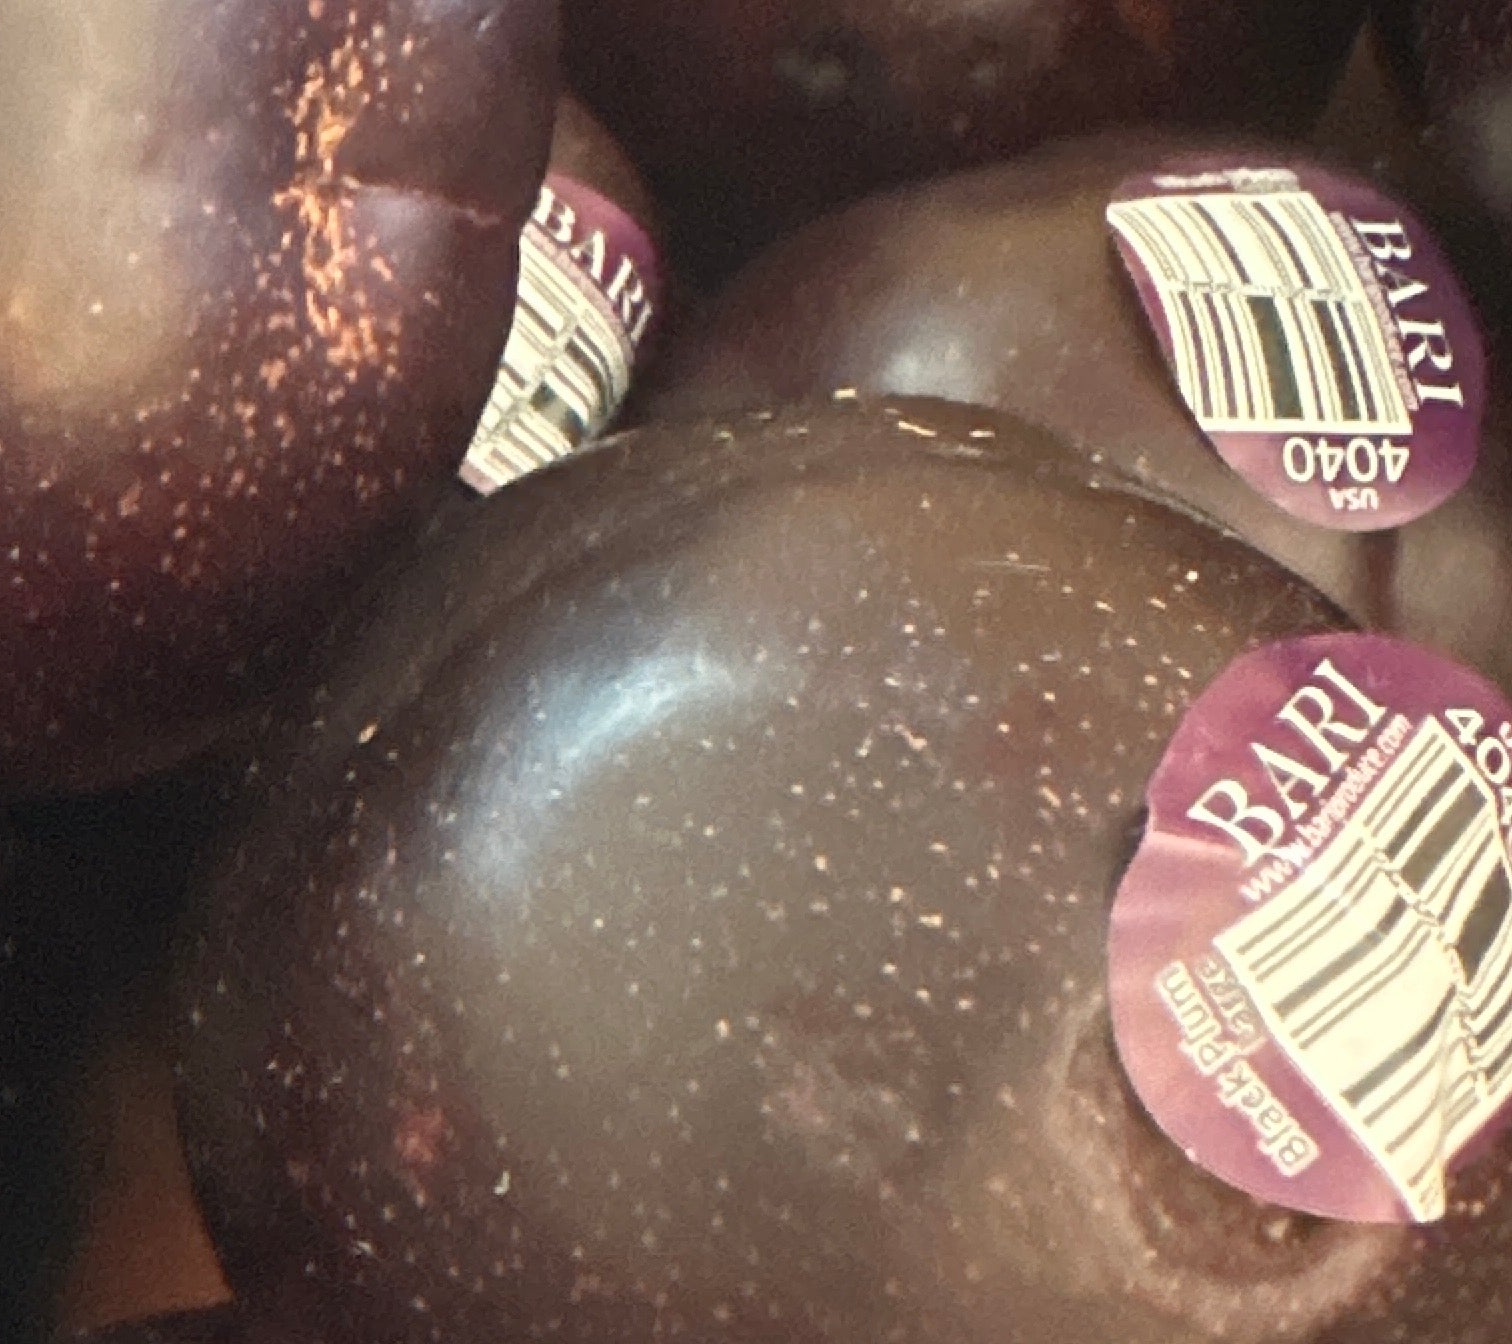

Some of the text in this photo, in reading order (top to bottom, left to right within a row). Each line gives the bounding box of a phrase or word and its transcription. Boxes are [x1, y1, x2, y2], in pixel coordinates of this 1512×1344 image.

[533, 186, 653, 342] BARI
[1351, 216, 1465, 409] BARI
[1282, 436, 1410, 483] 4040
[1328, 487, 1379, 510] USA
[1188, 658, 1387, 868] BARI
[1159, 963, 1316, 1172] Black Plum
